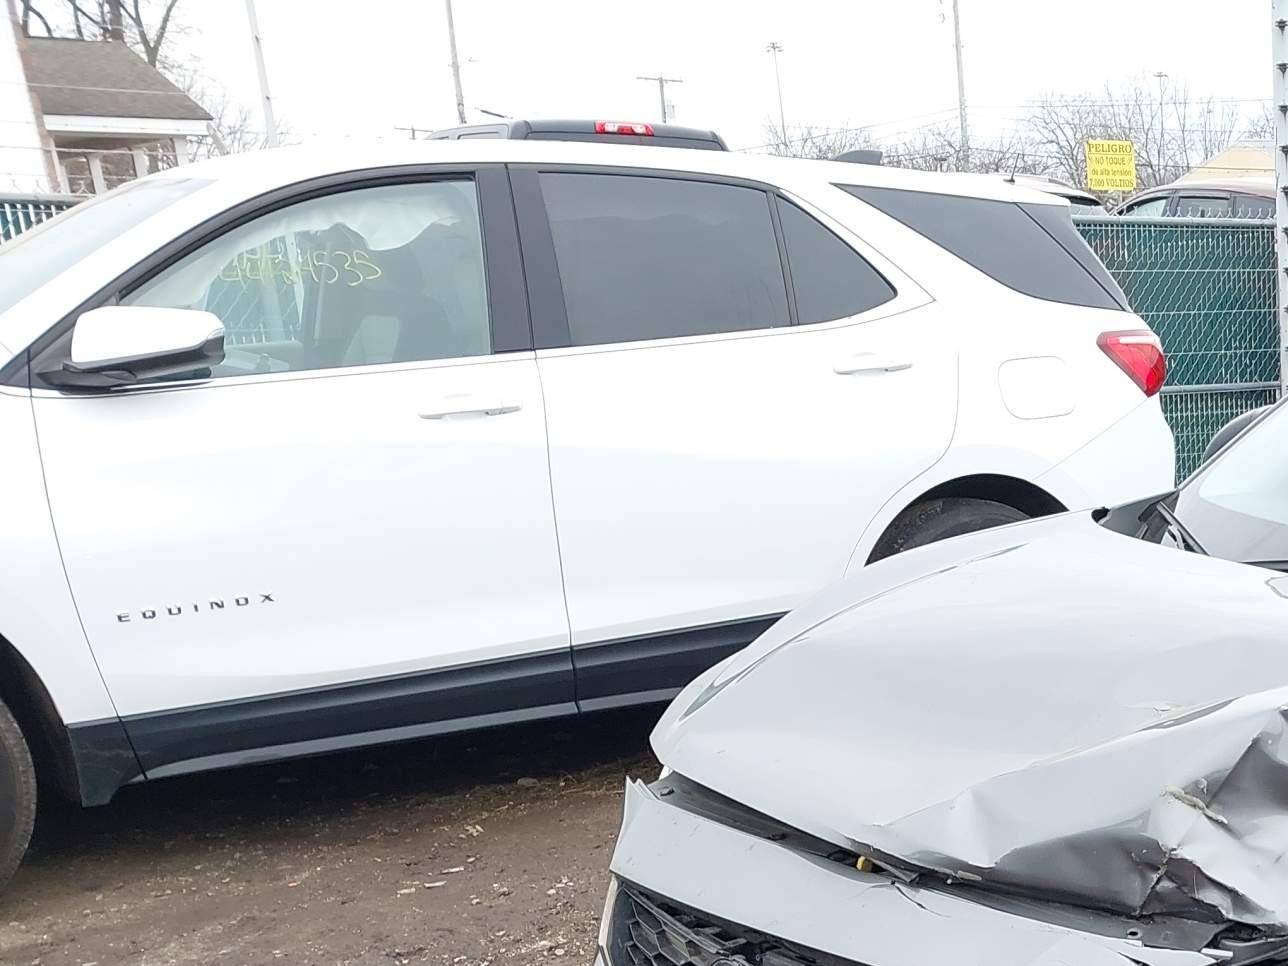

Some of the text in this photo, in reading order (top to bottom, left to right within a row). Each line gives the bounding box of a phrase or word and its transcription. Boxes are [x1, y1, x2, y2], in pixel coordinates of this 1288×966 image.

[1088, 143, 1132, 153] PELIGRO
[1095, 156, 1126, 165] NO TOQUE
[1106, 178, 1134, 188] VOLTIOS
[116, 593, 275, 623] EQUINOX
